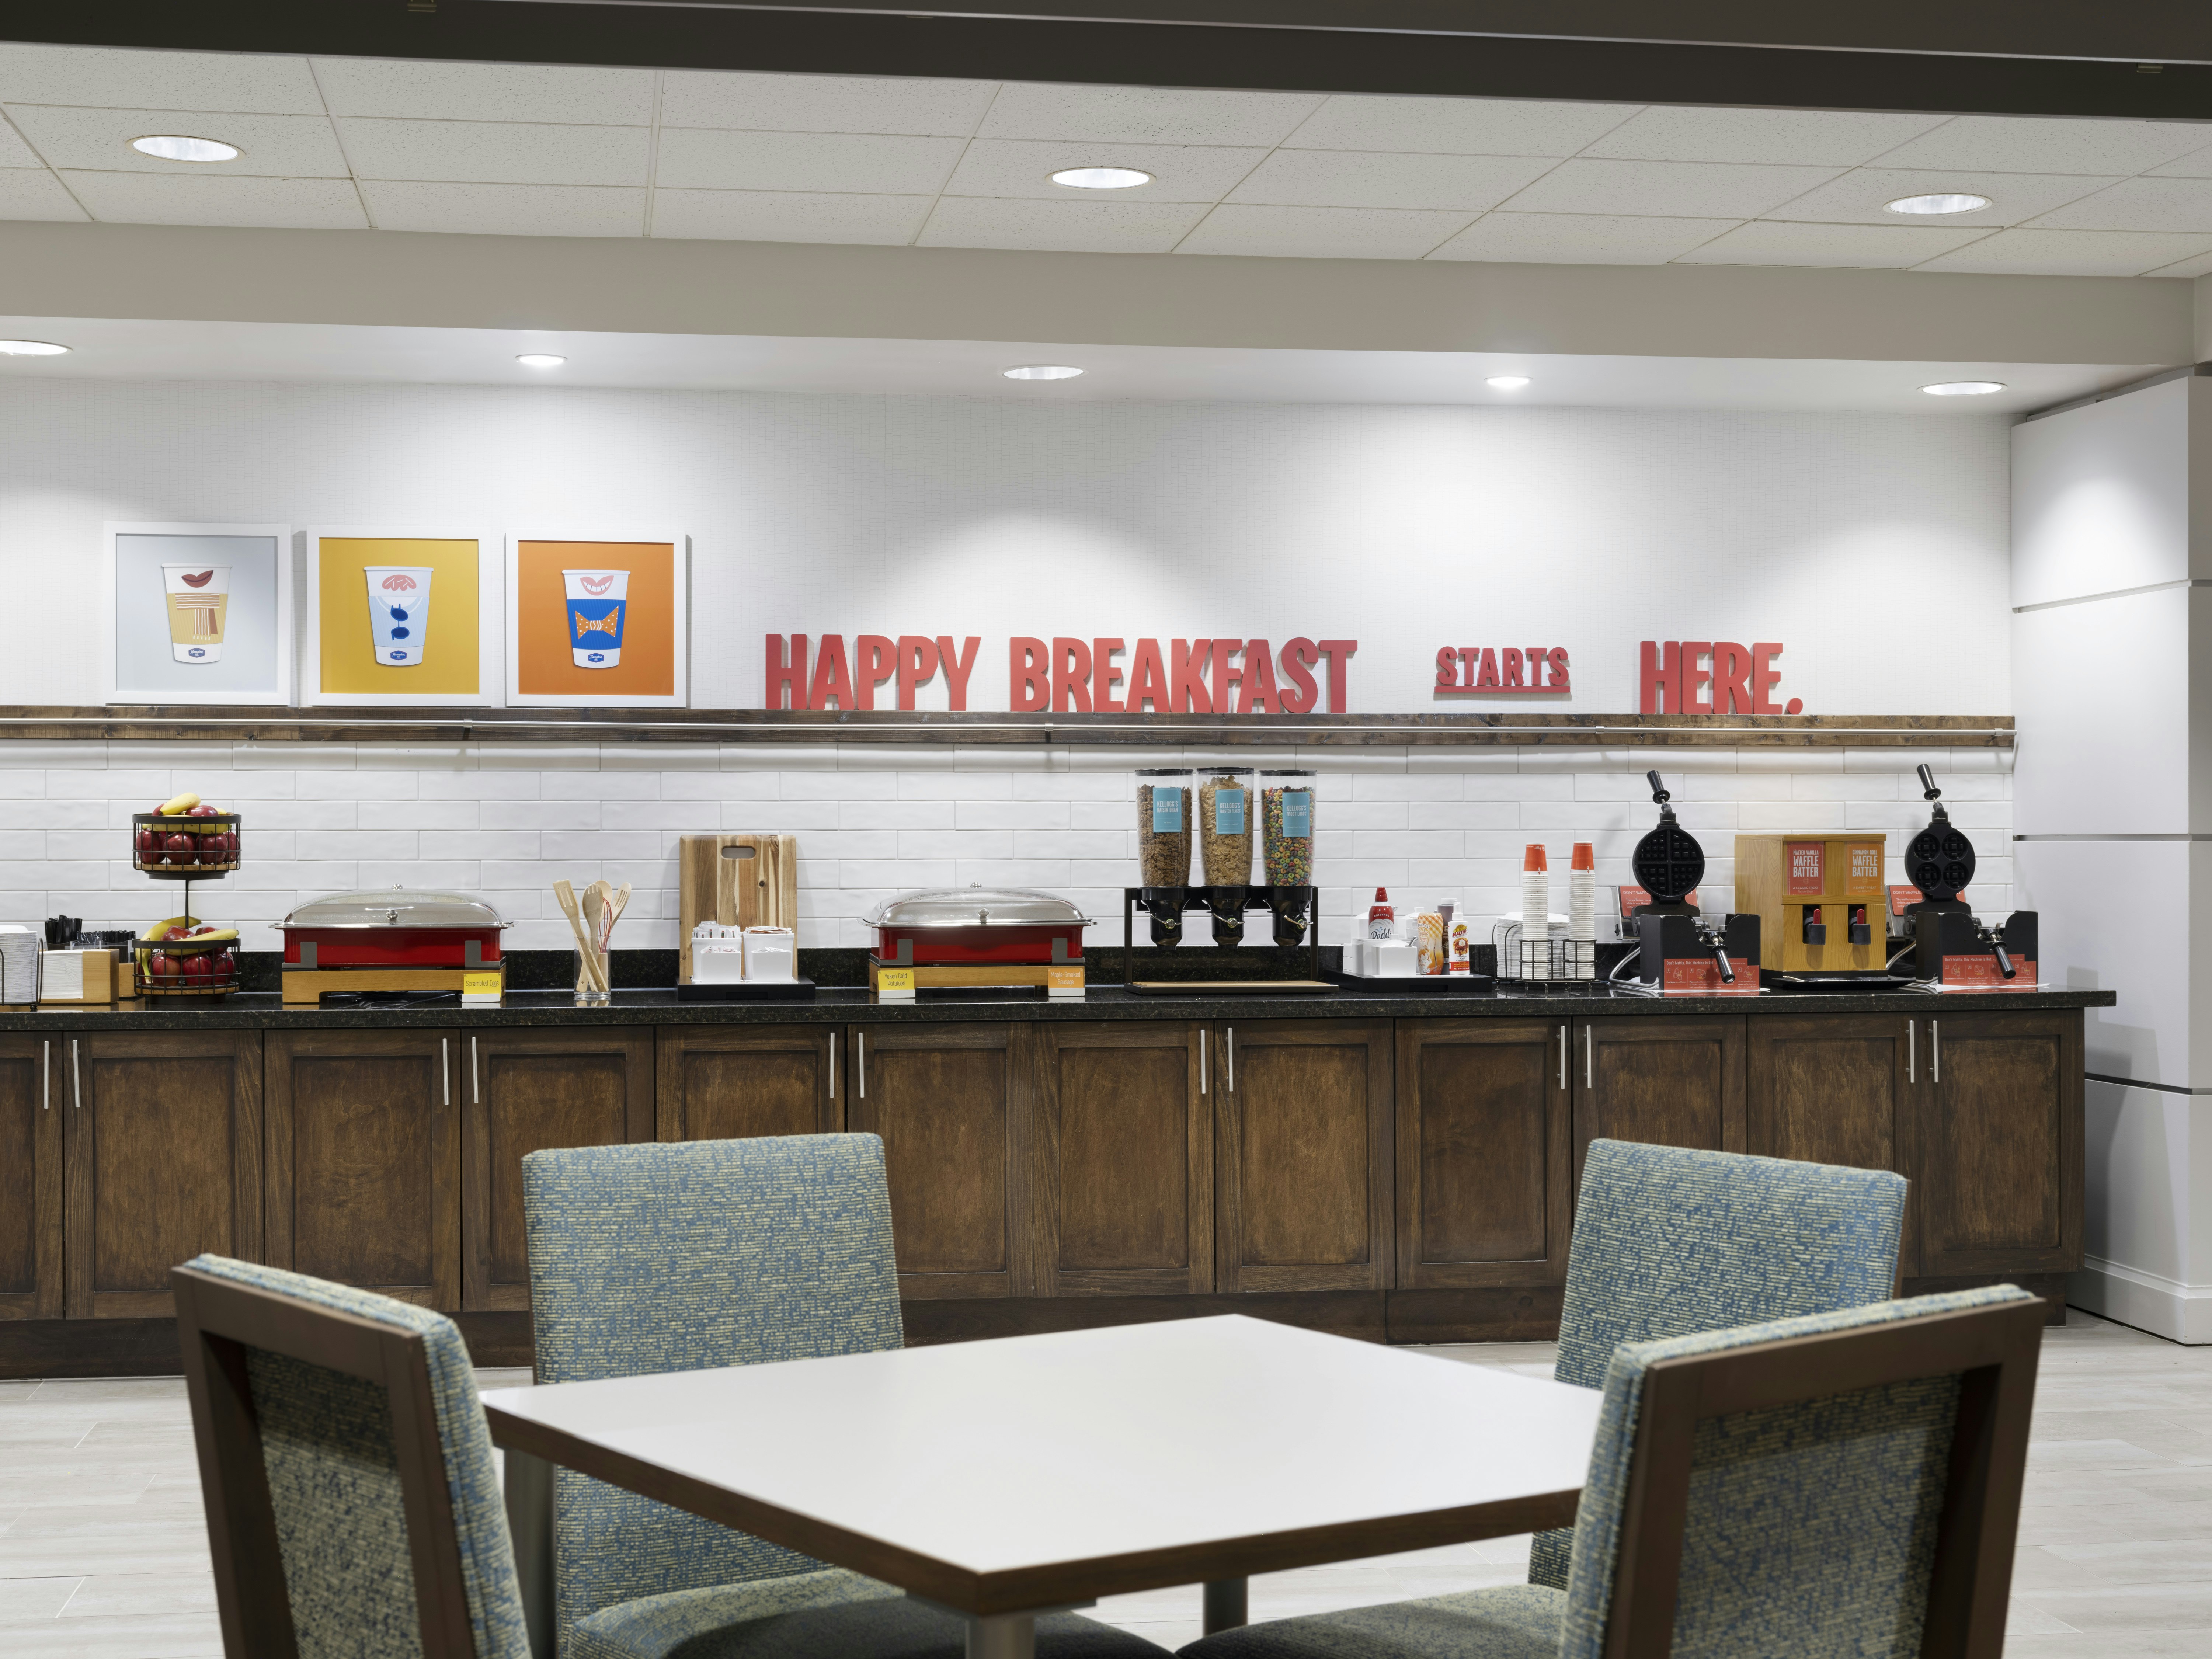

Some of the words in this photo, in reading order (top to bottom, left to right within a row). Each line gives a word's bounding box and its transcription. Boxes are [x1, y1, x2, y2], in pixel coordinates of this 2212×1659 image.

[765, 634, 981, 711] HAPPY
[1010, 636, 1357, 714] BREAKFAST
[1437, 646, 1569, 685] STARTS
[1640, 641, 1803, 714] HERE.
[1794, 856, 1819, 866] WAFFLE
[1853, 856, 1878, 866] WAFFLE
[1793, 867, 1818, 877] BATTER
[1853, 867, 1877, 877] BATTER
[1452, 929, 1467, 937] MALTED
